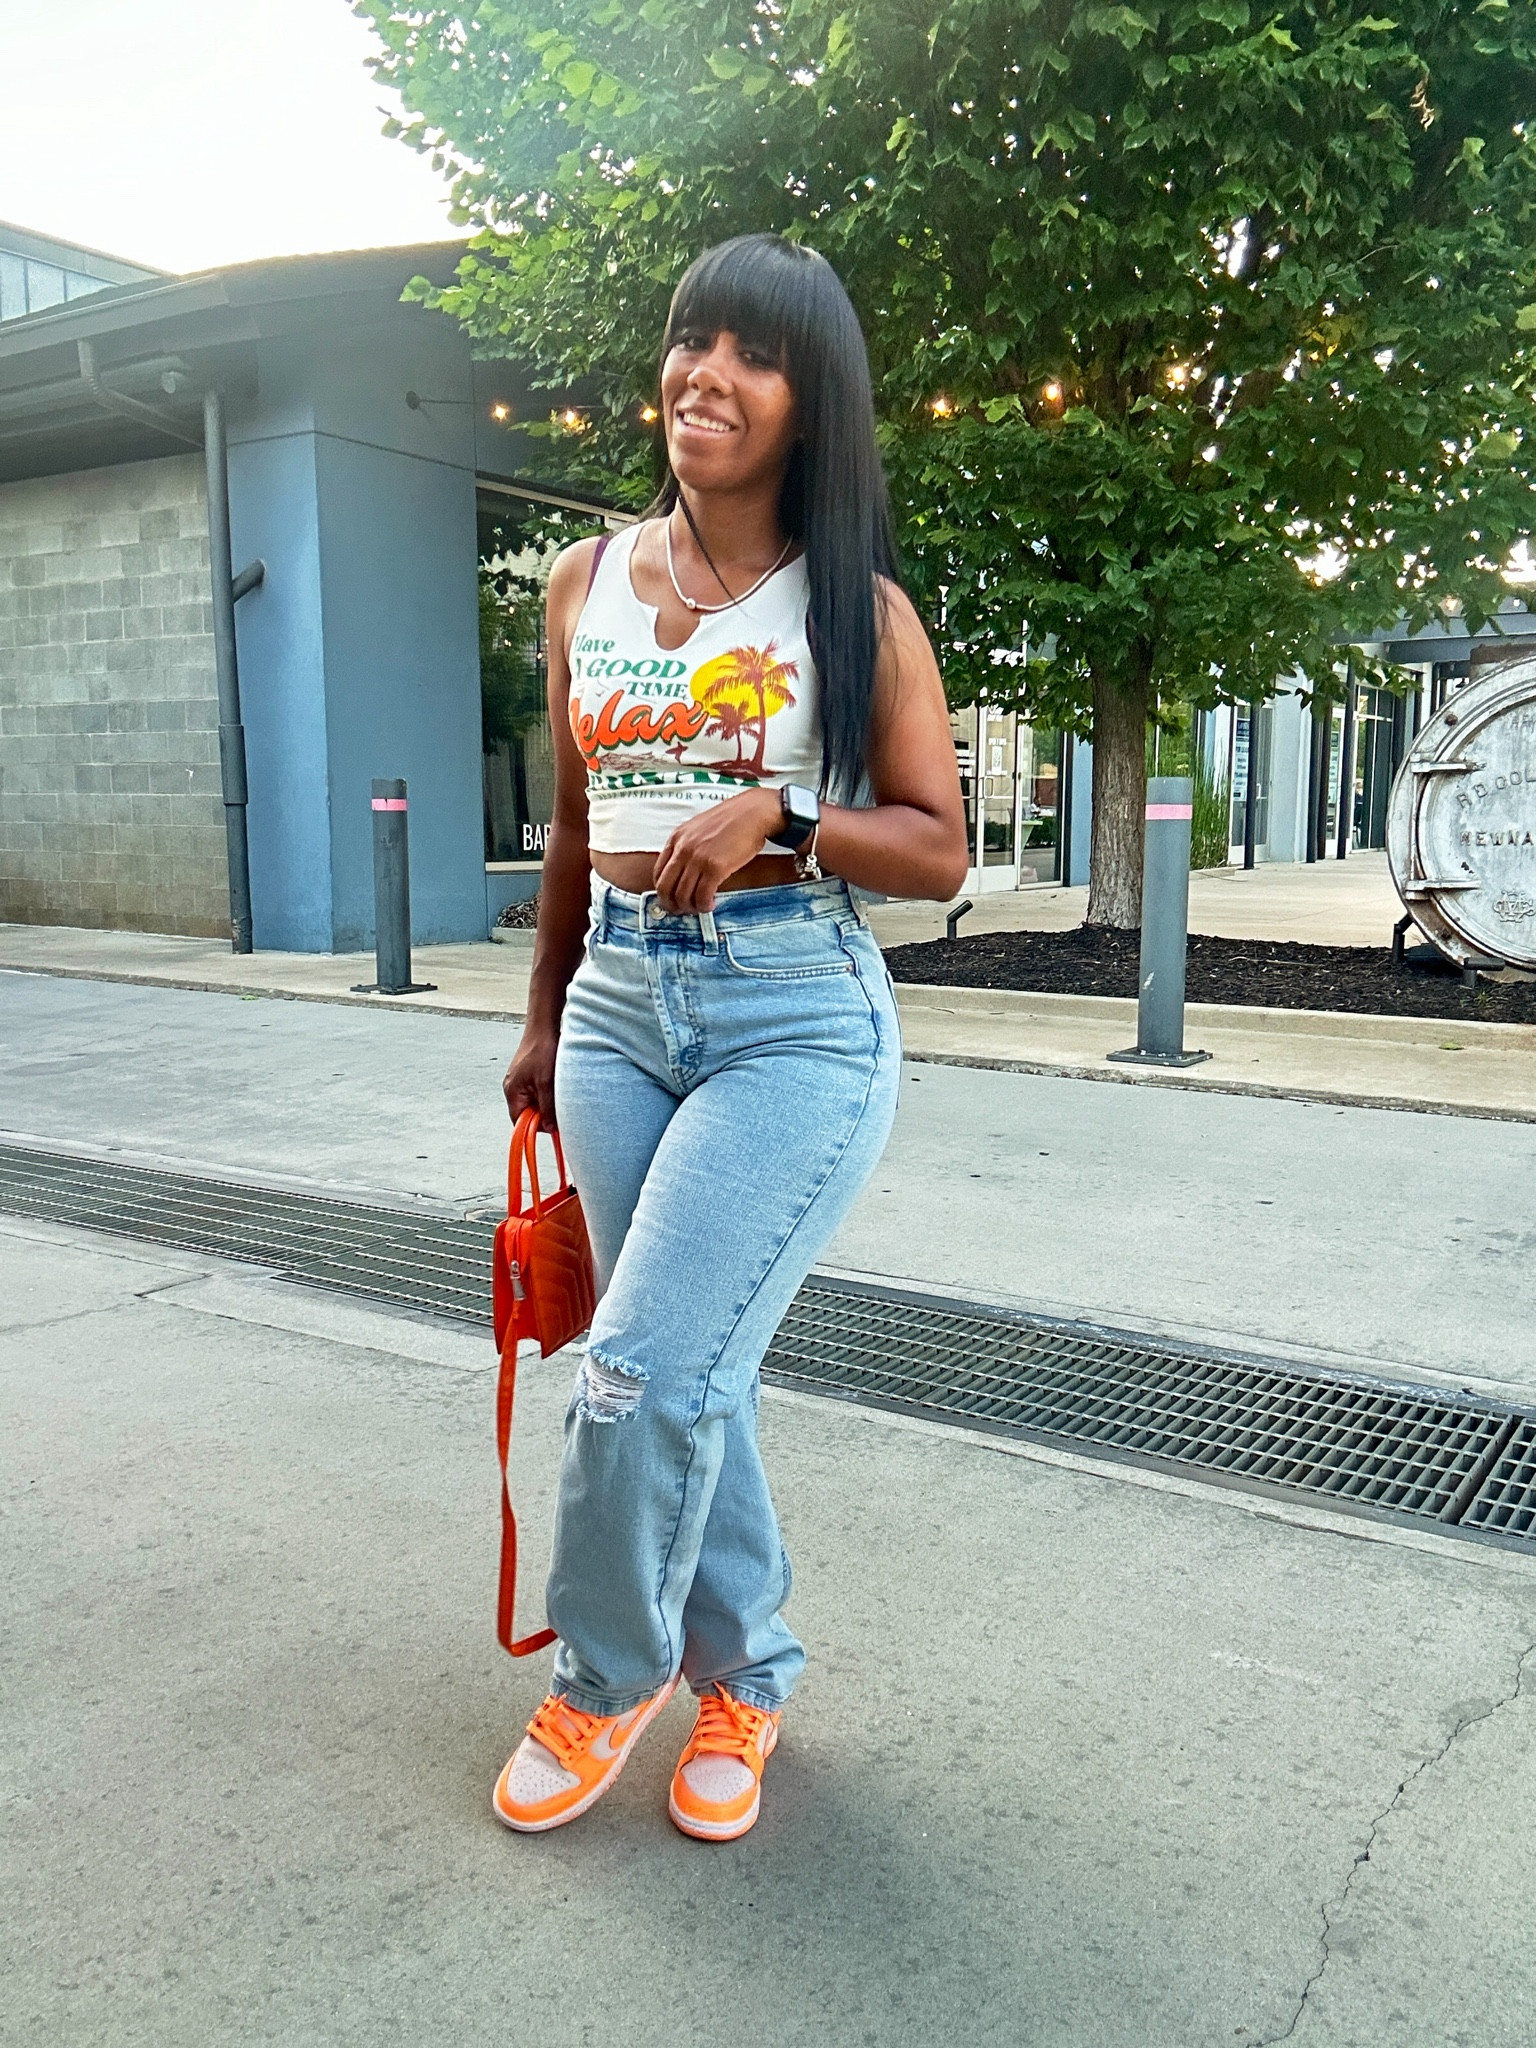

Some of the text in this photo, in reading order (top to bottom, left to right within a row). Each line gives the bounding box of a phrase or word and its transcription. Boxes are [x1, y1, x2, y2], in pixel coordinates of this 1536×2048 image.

[587, 658, 687, 678] GOOD
[625, 681, 689, 698] TIME
[668, 791, 693, 800] FOR
